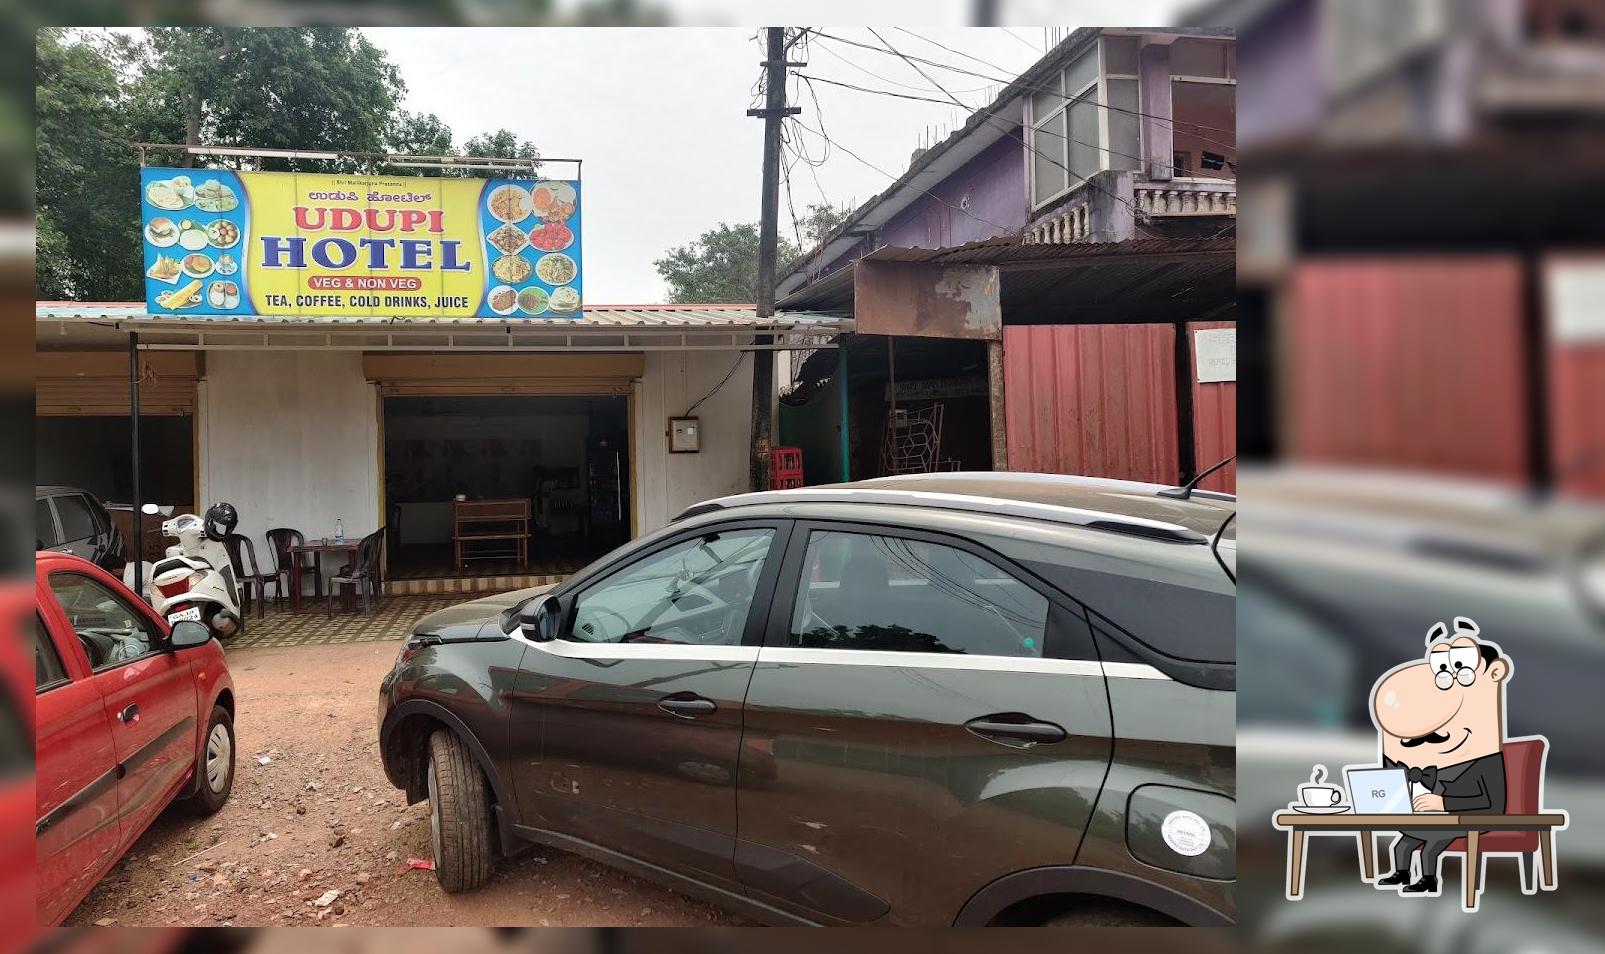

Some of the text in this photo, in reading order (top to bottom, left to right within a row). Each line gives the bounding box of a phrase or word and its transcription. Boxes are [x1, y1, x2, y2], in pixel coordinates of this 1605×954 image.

[309, 190, 358, 201] ಉಡುಪಿ
[293, 207, 444, 232] UDUPI
[260, 236, 471, 271] HOTEL
[313, 277, 417, 289] VEG & NON VEG
[265, 294, 469, 309] TEA, COFFEE, COLD DRINKS, JUICE
